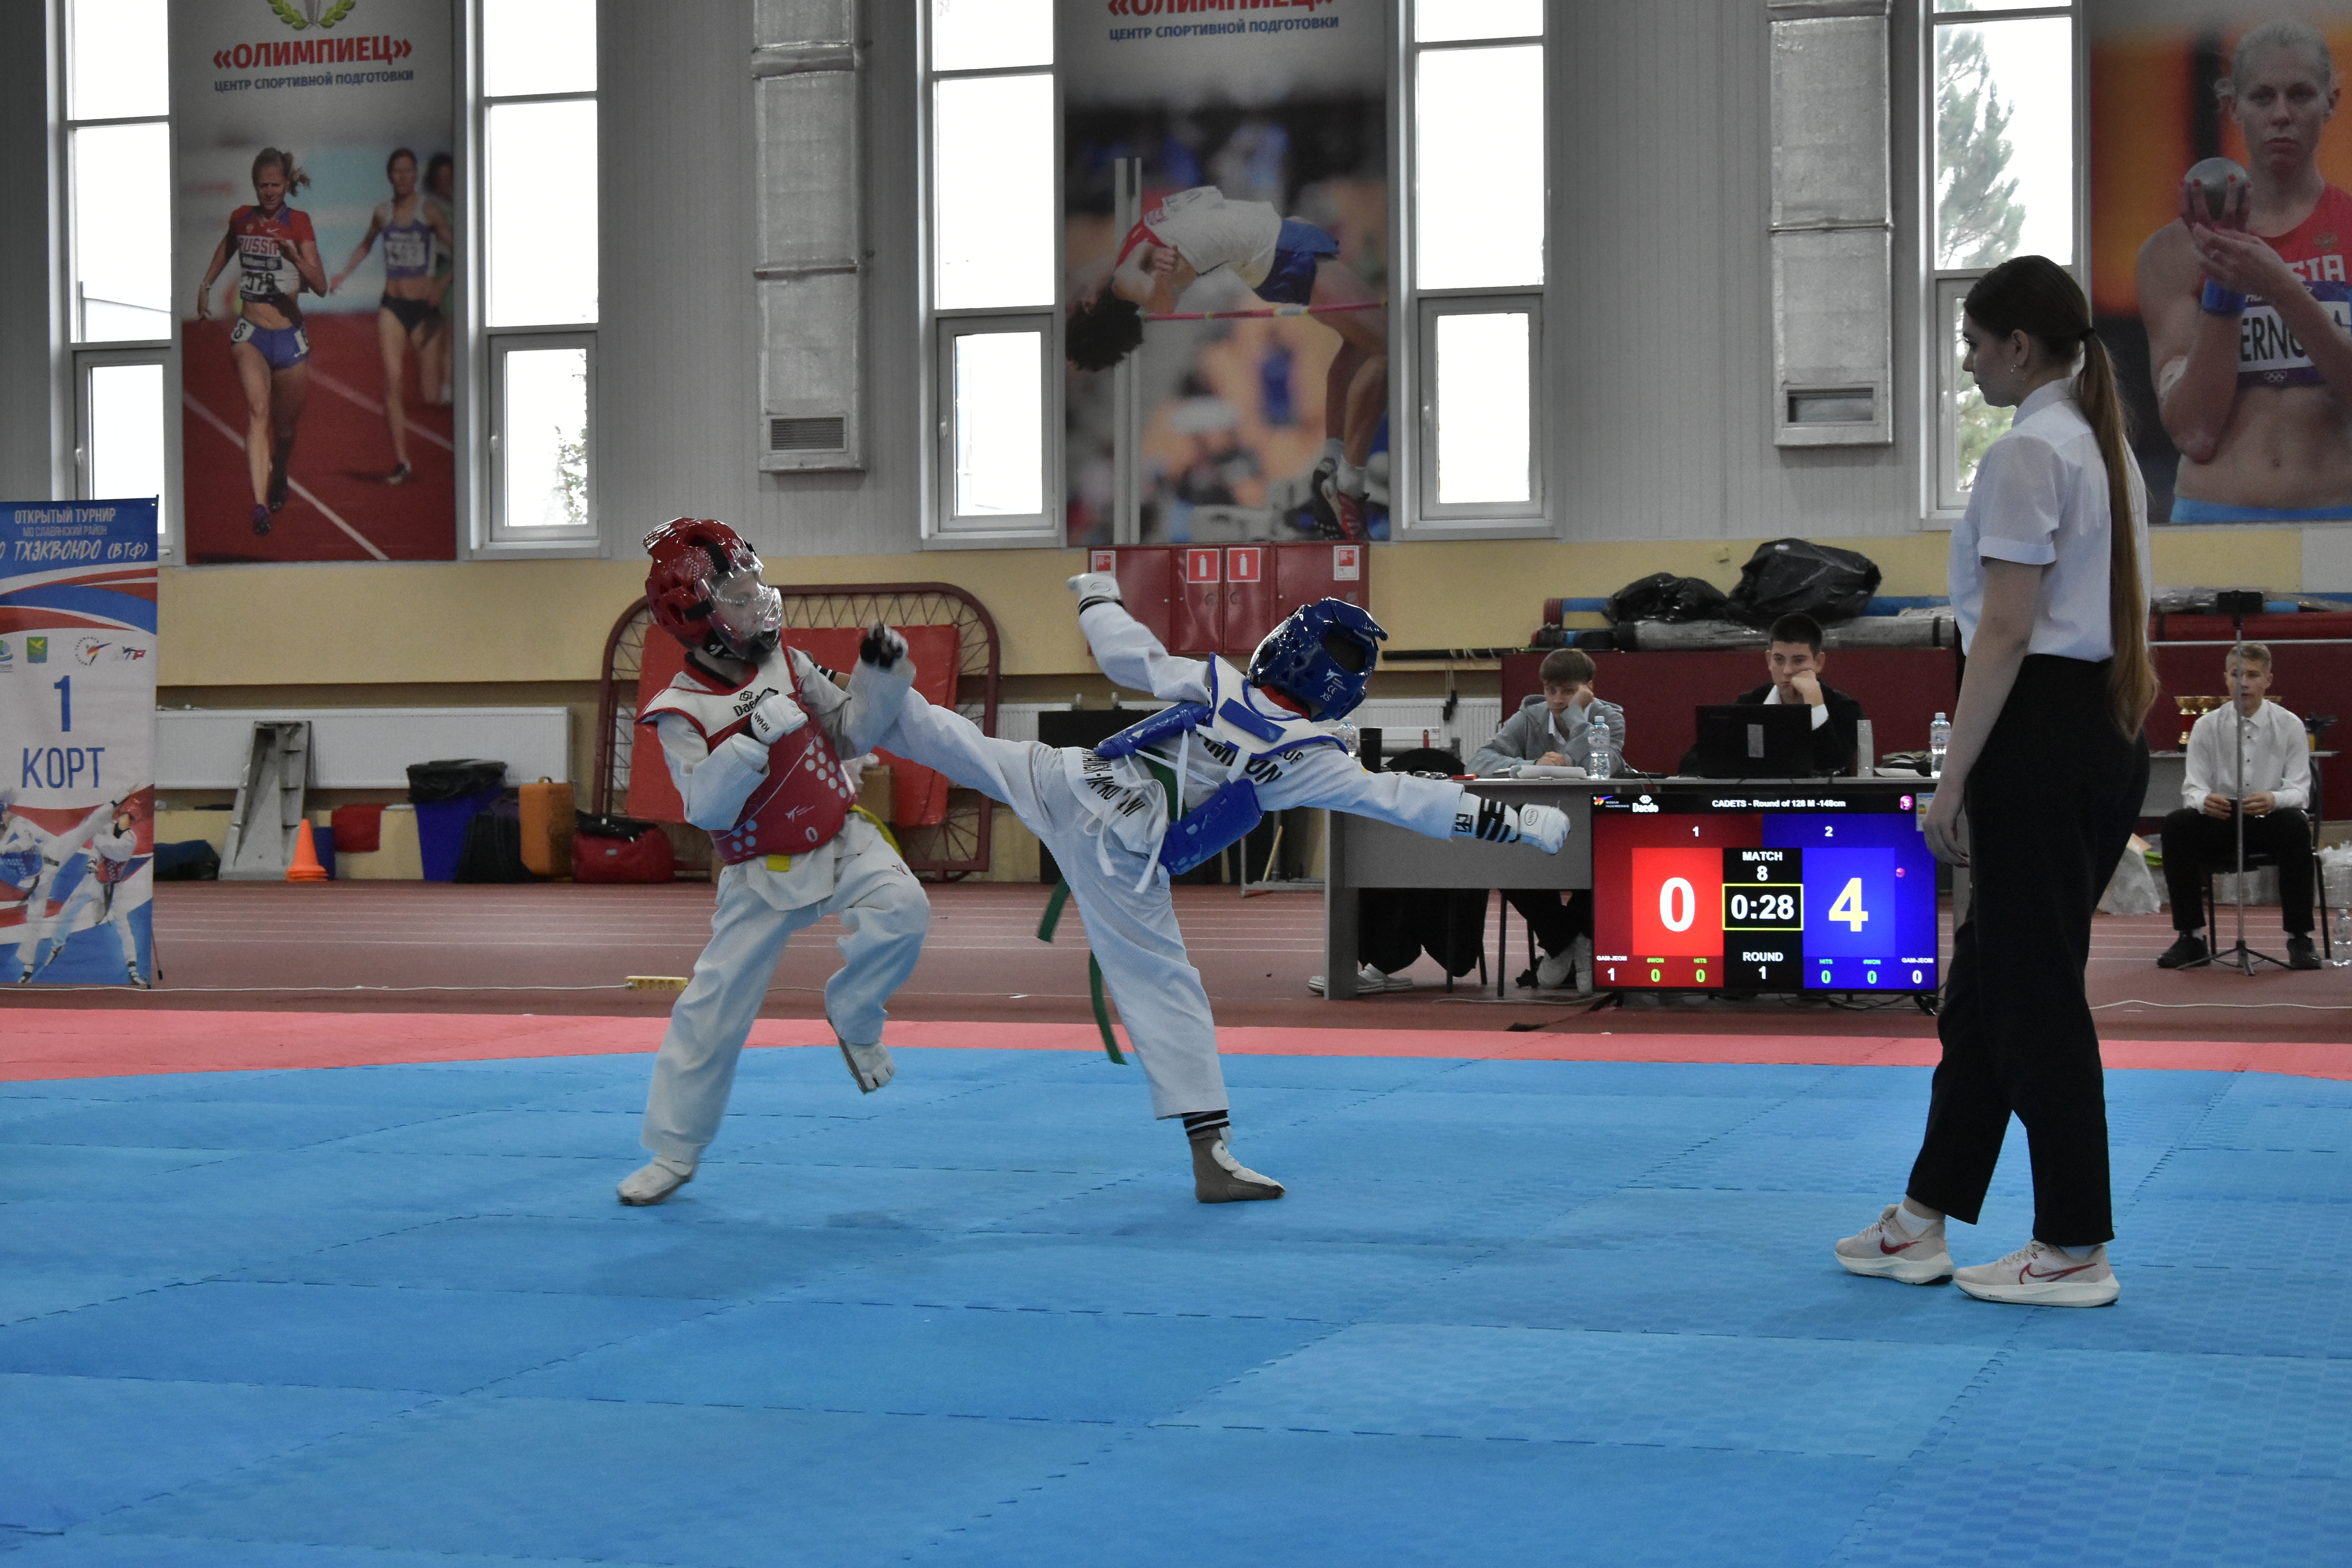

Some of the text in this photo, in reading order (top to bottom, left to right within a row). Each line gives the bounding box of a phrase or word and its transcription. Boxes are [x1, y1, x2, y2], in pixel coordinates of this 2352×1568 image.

[1109, 16, 1339, 41] ЦЕНТР СПОРТИВНОЙ ПОДГОТОВКИ
[213, 35, 412, 69] «ОЛИМПИЕЦ»
[214, 70, 414, 93] ЦЕНТР СПОРТИВНОЙ ПОДГОТОВКИ
[15, 507, 116, 524] ОТКРЫТЫЙ ТУРНИР
[107, 542, 148, 560] (ВТФ)
[54, 675, 71, 731] 1
[22, 748, 105, 788] КОРТ
[1632, 802, 1659, 813] Daedo
[1904, 799, 1910, 807] 5
[1692, 826, 1700, 837] 1
[1825, 826, 1833, 837] 2
[1742, 851, 1782, 861] MATCH
[1757, 866, 1768, 881] 8
[1659, 877, 1695, 932] 0
[1731, 894, 1794, 920] 0:28
[1828, 877, 1869, 932] 4
[1742, 952, 1783, 962] ROUND
[1608, 967, 1615, 981] 1
[1651, 969, 1661, 982] 0
[1696, 969, 1706, 982] 0
[1759, 967, 1766, 979] 1
[1821, 970, 1831, 984] 0
[1867, 971, 1877, 984] 0
[1912, 970, 1922, 984] 0
